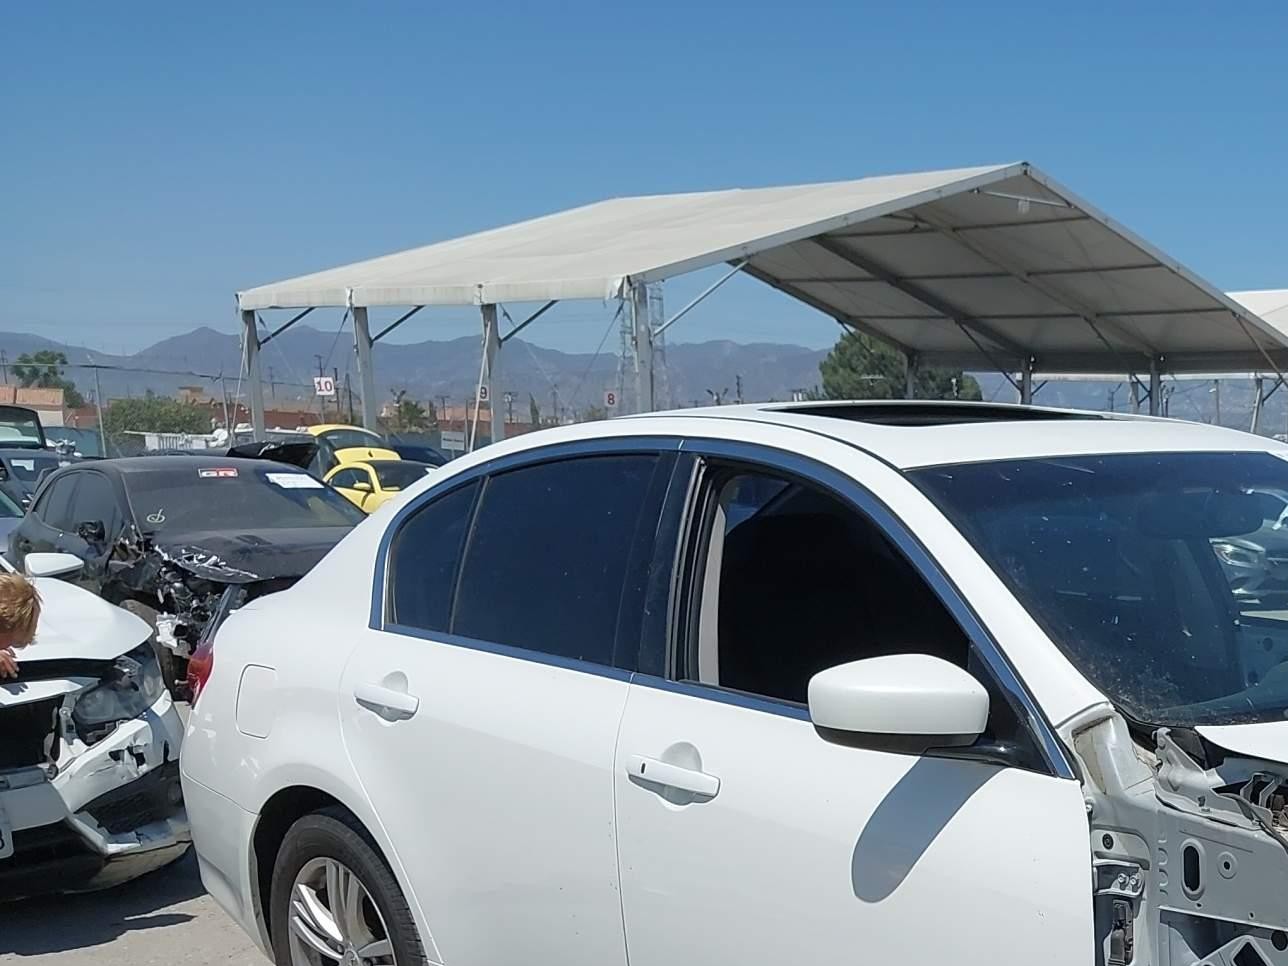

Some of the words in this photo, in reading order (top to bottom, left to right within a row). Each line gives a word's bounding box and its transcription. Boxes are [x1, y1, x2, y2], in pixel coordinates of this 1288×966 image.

[316, 380, 333, 392] 10
[479, 386, 488, 399] 9
[607, 392, 615, 405] 8
[200, 469, 237, 477] GR
